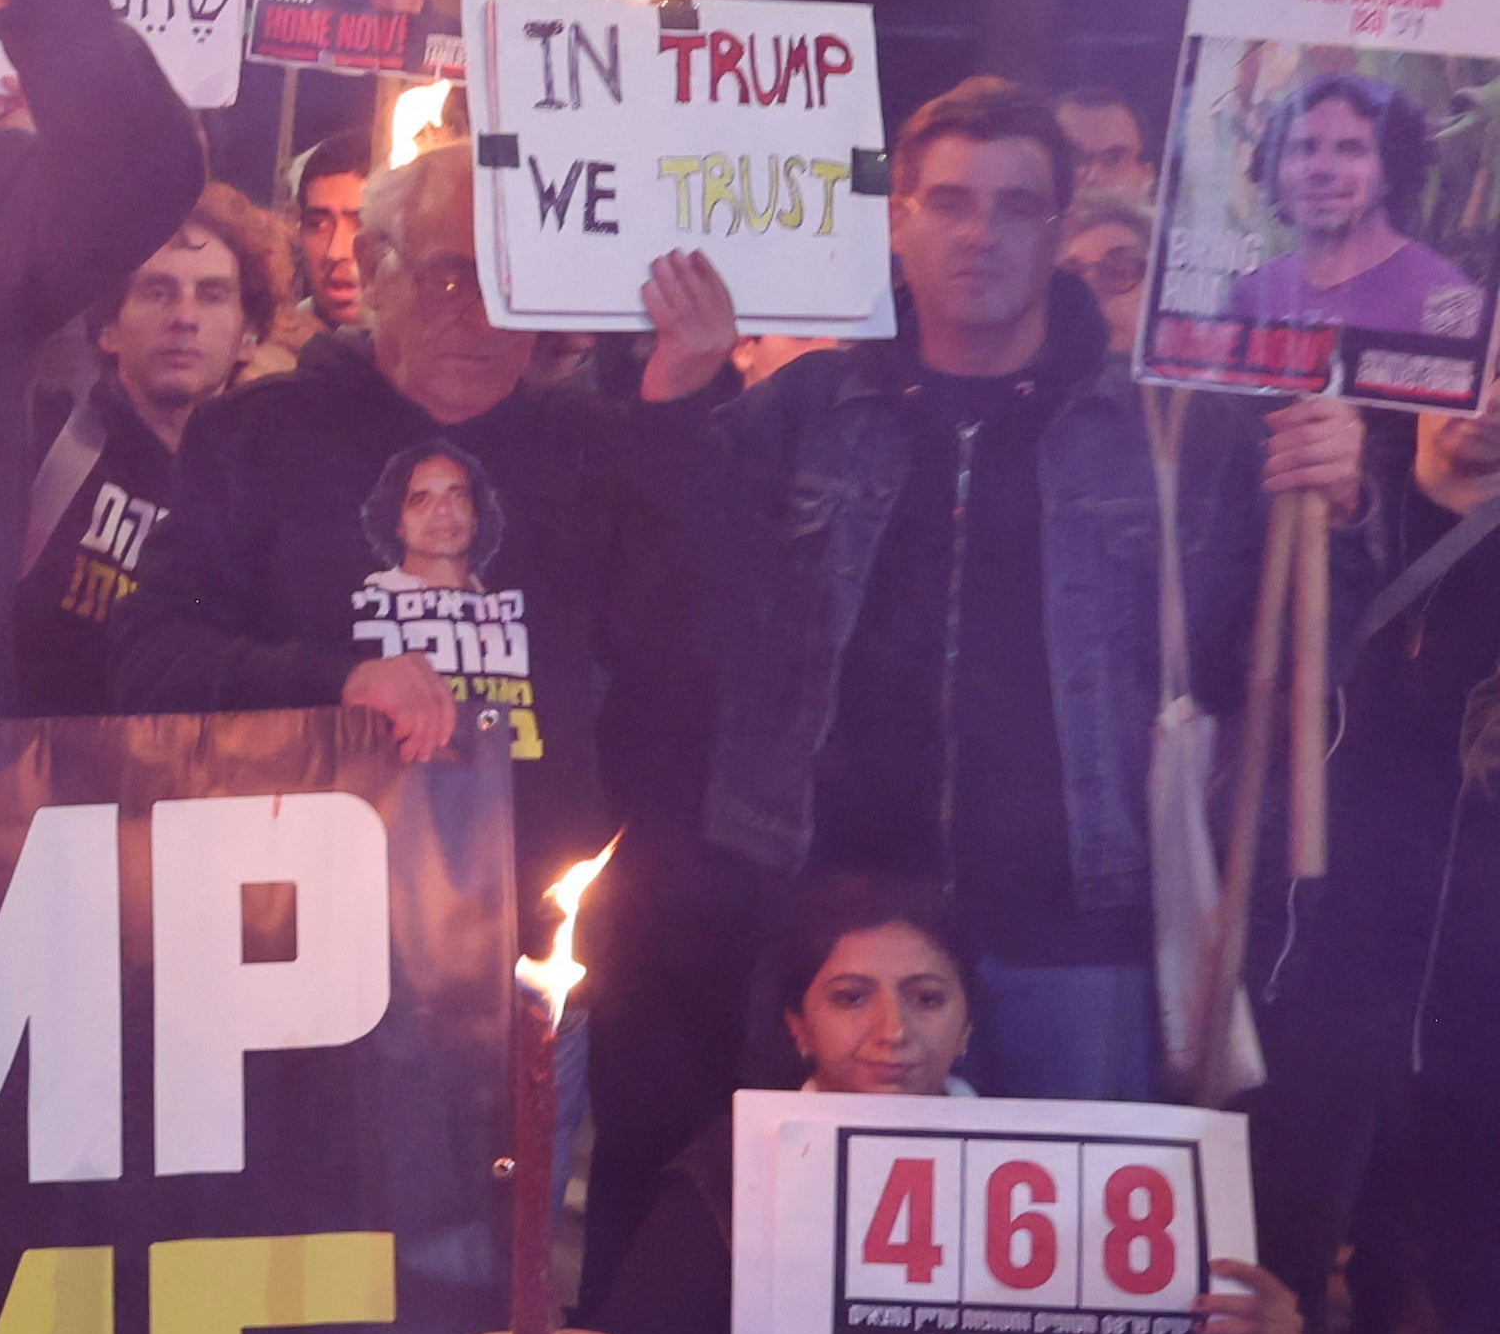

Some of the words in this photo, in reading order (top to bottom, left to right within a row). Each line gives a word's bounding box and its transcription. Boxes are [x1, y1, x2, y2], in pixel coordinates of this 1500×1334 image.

[264, 4, 334, 48] HOME
[337, 12, 409, 54] NOW!
[524, 20, 622, 110] IN
[659, 30, 853, 108] TRUMP
[527, 159, 618, 233] WE
[658, 156, 851, 235] TRUST
[351, 587, 390, 617] לי
[396, 589, 524, 622] קוראים
[353, 619, 529, 677] עופר
[862, 1158, 1176, 1296] 468
